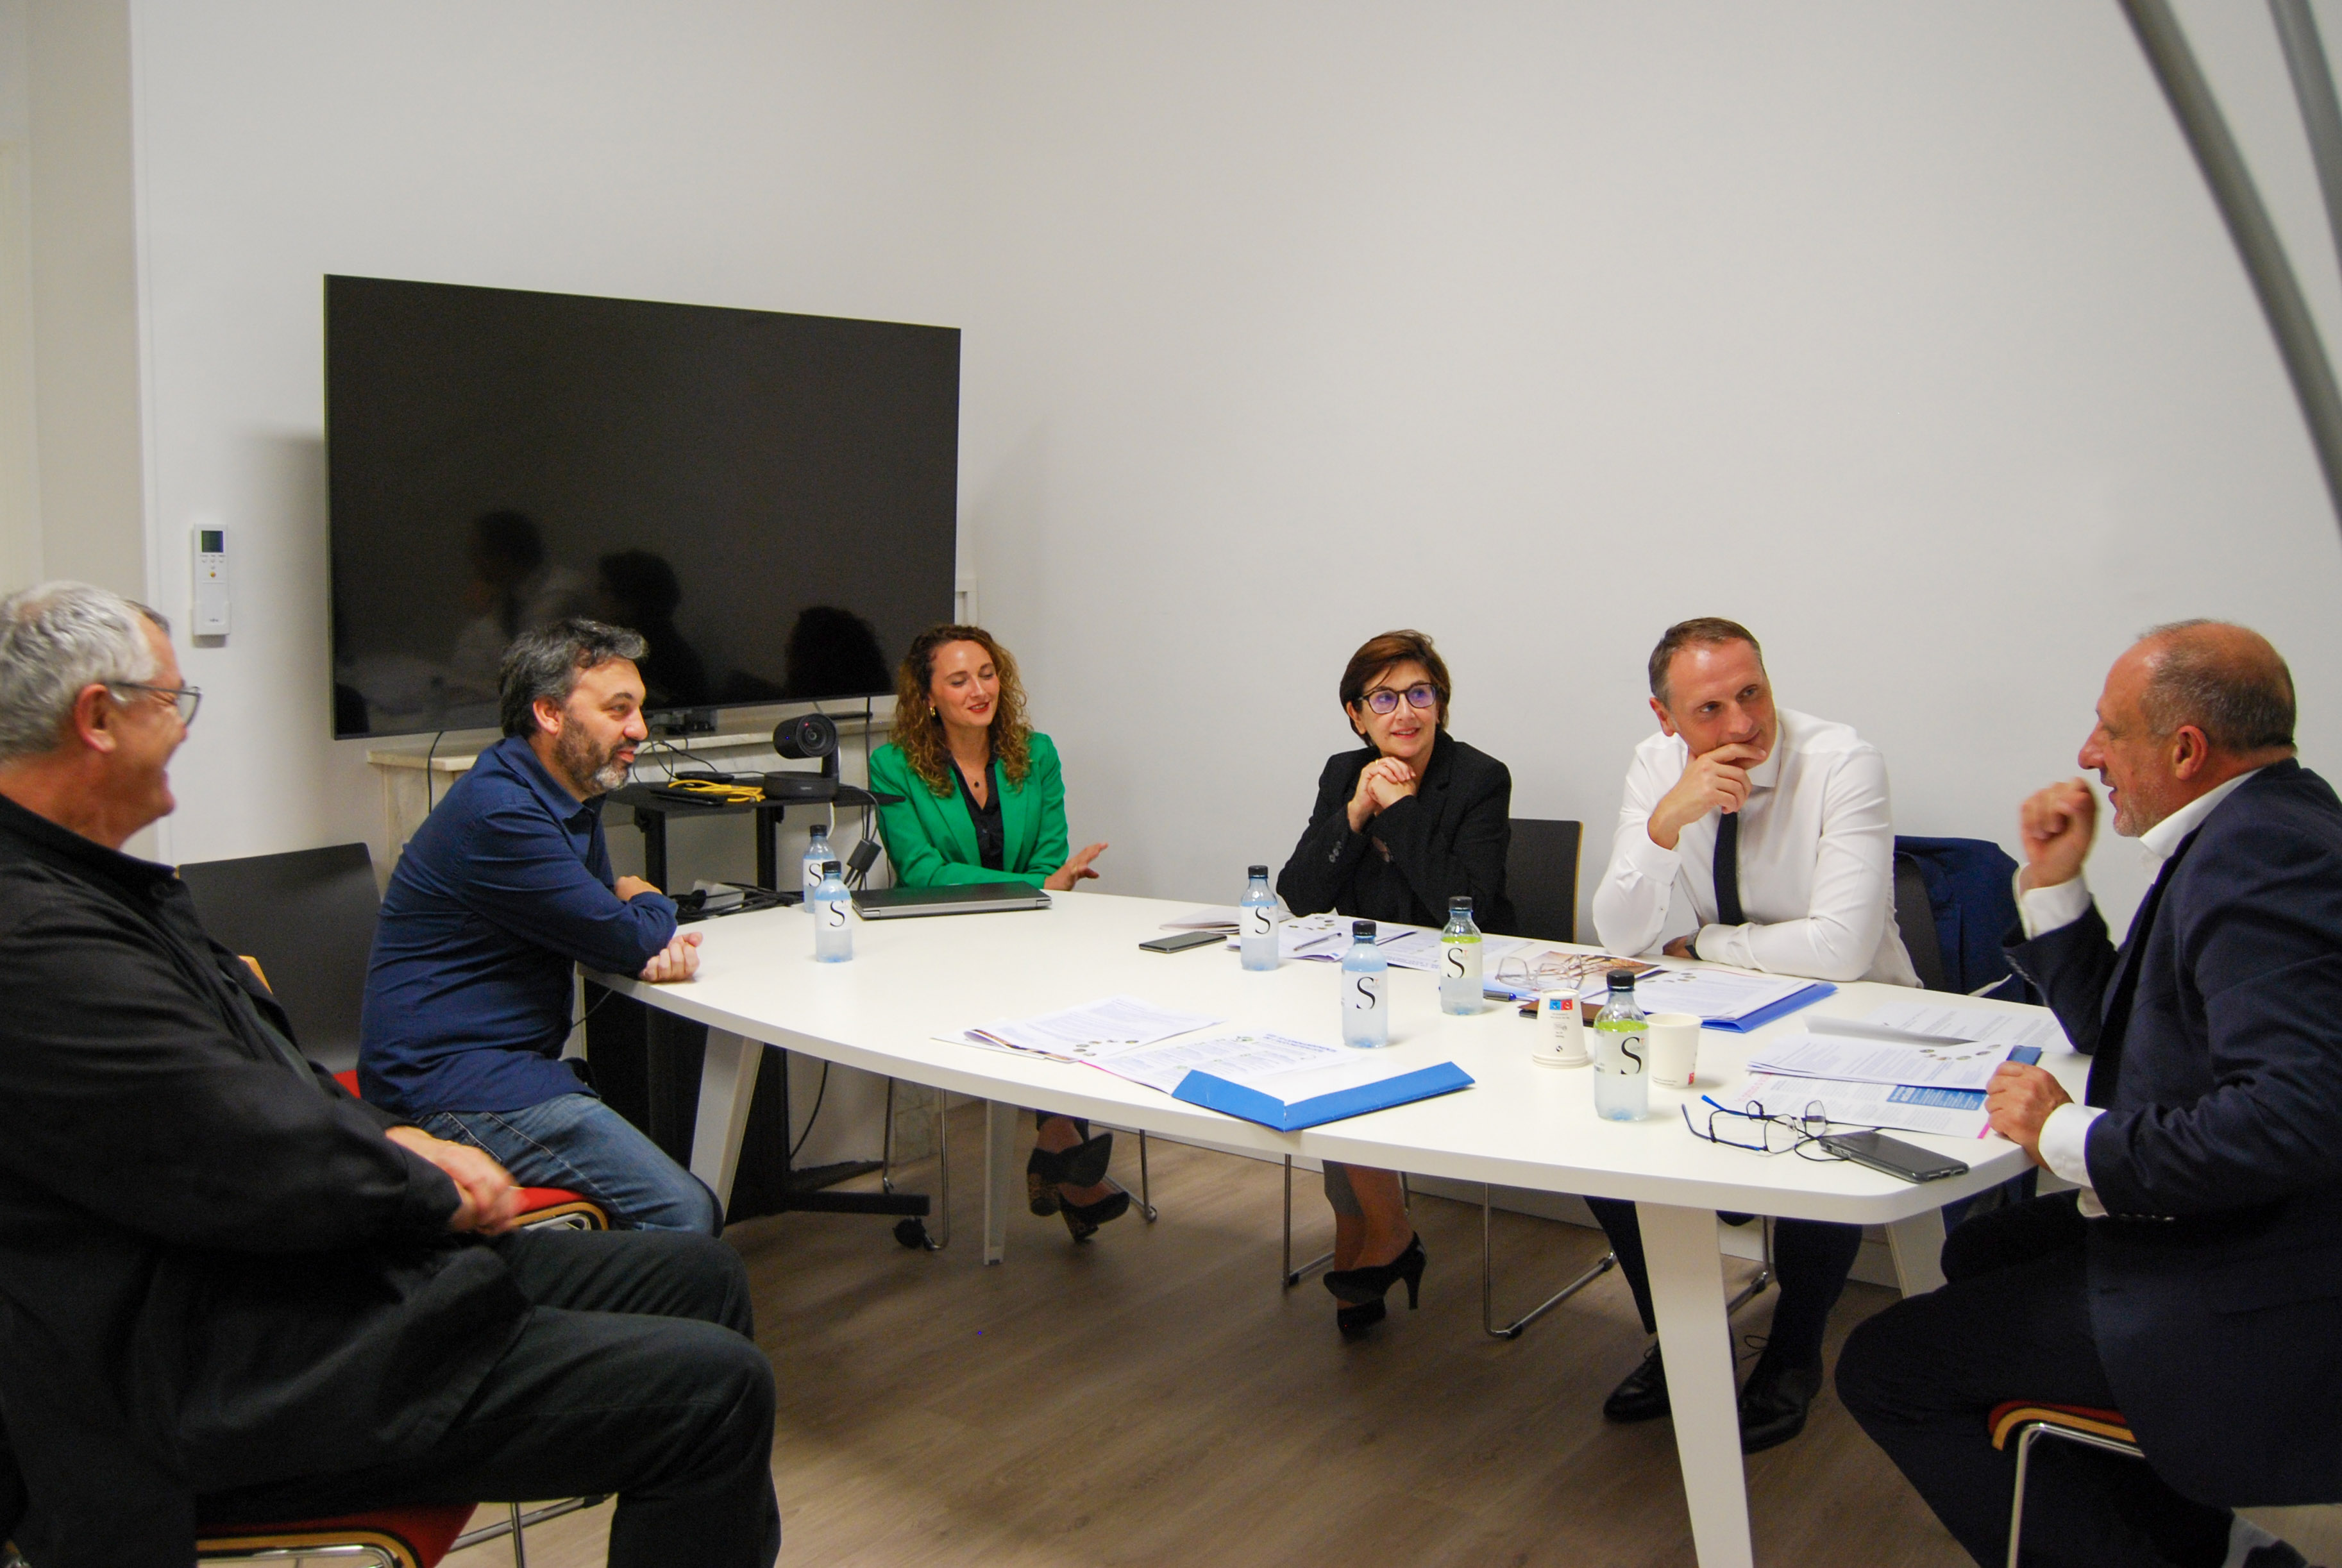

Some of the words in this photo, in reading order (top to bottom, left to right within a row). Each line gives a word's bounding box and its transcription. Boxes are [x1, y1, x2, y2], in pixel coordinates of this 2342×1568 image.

[809, 863, 821, 888] S
[830, 900, 845, 927] S
[1255, 906, 1270, 934] S
[1447, 947, 1465, 979] S
[1356, 977, 1376, 1009] S
[1621, 1036, 1642, 1075] S
